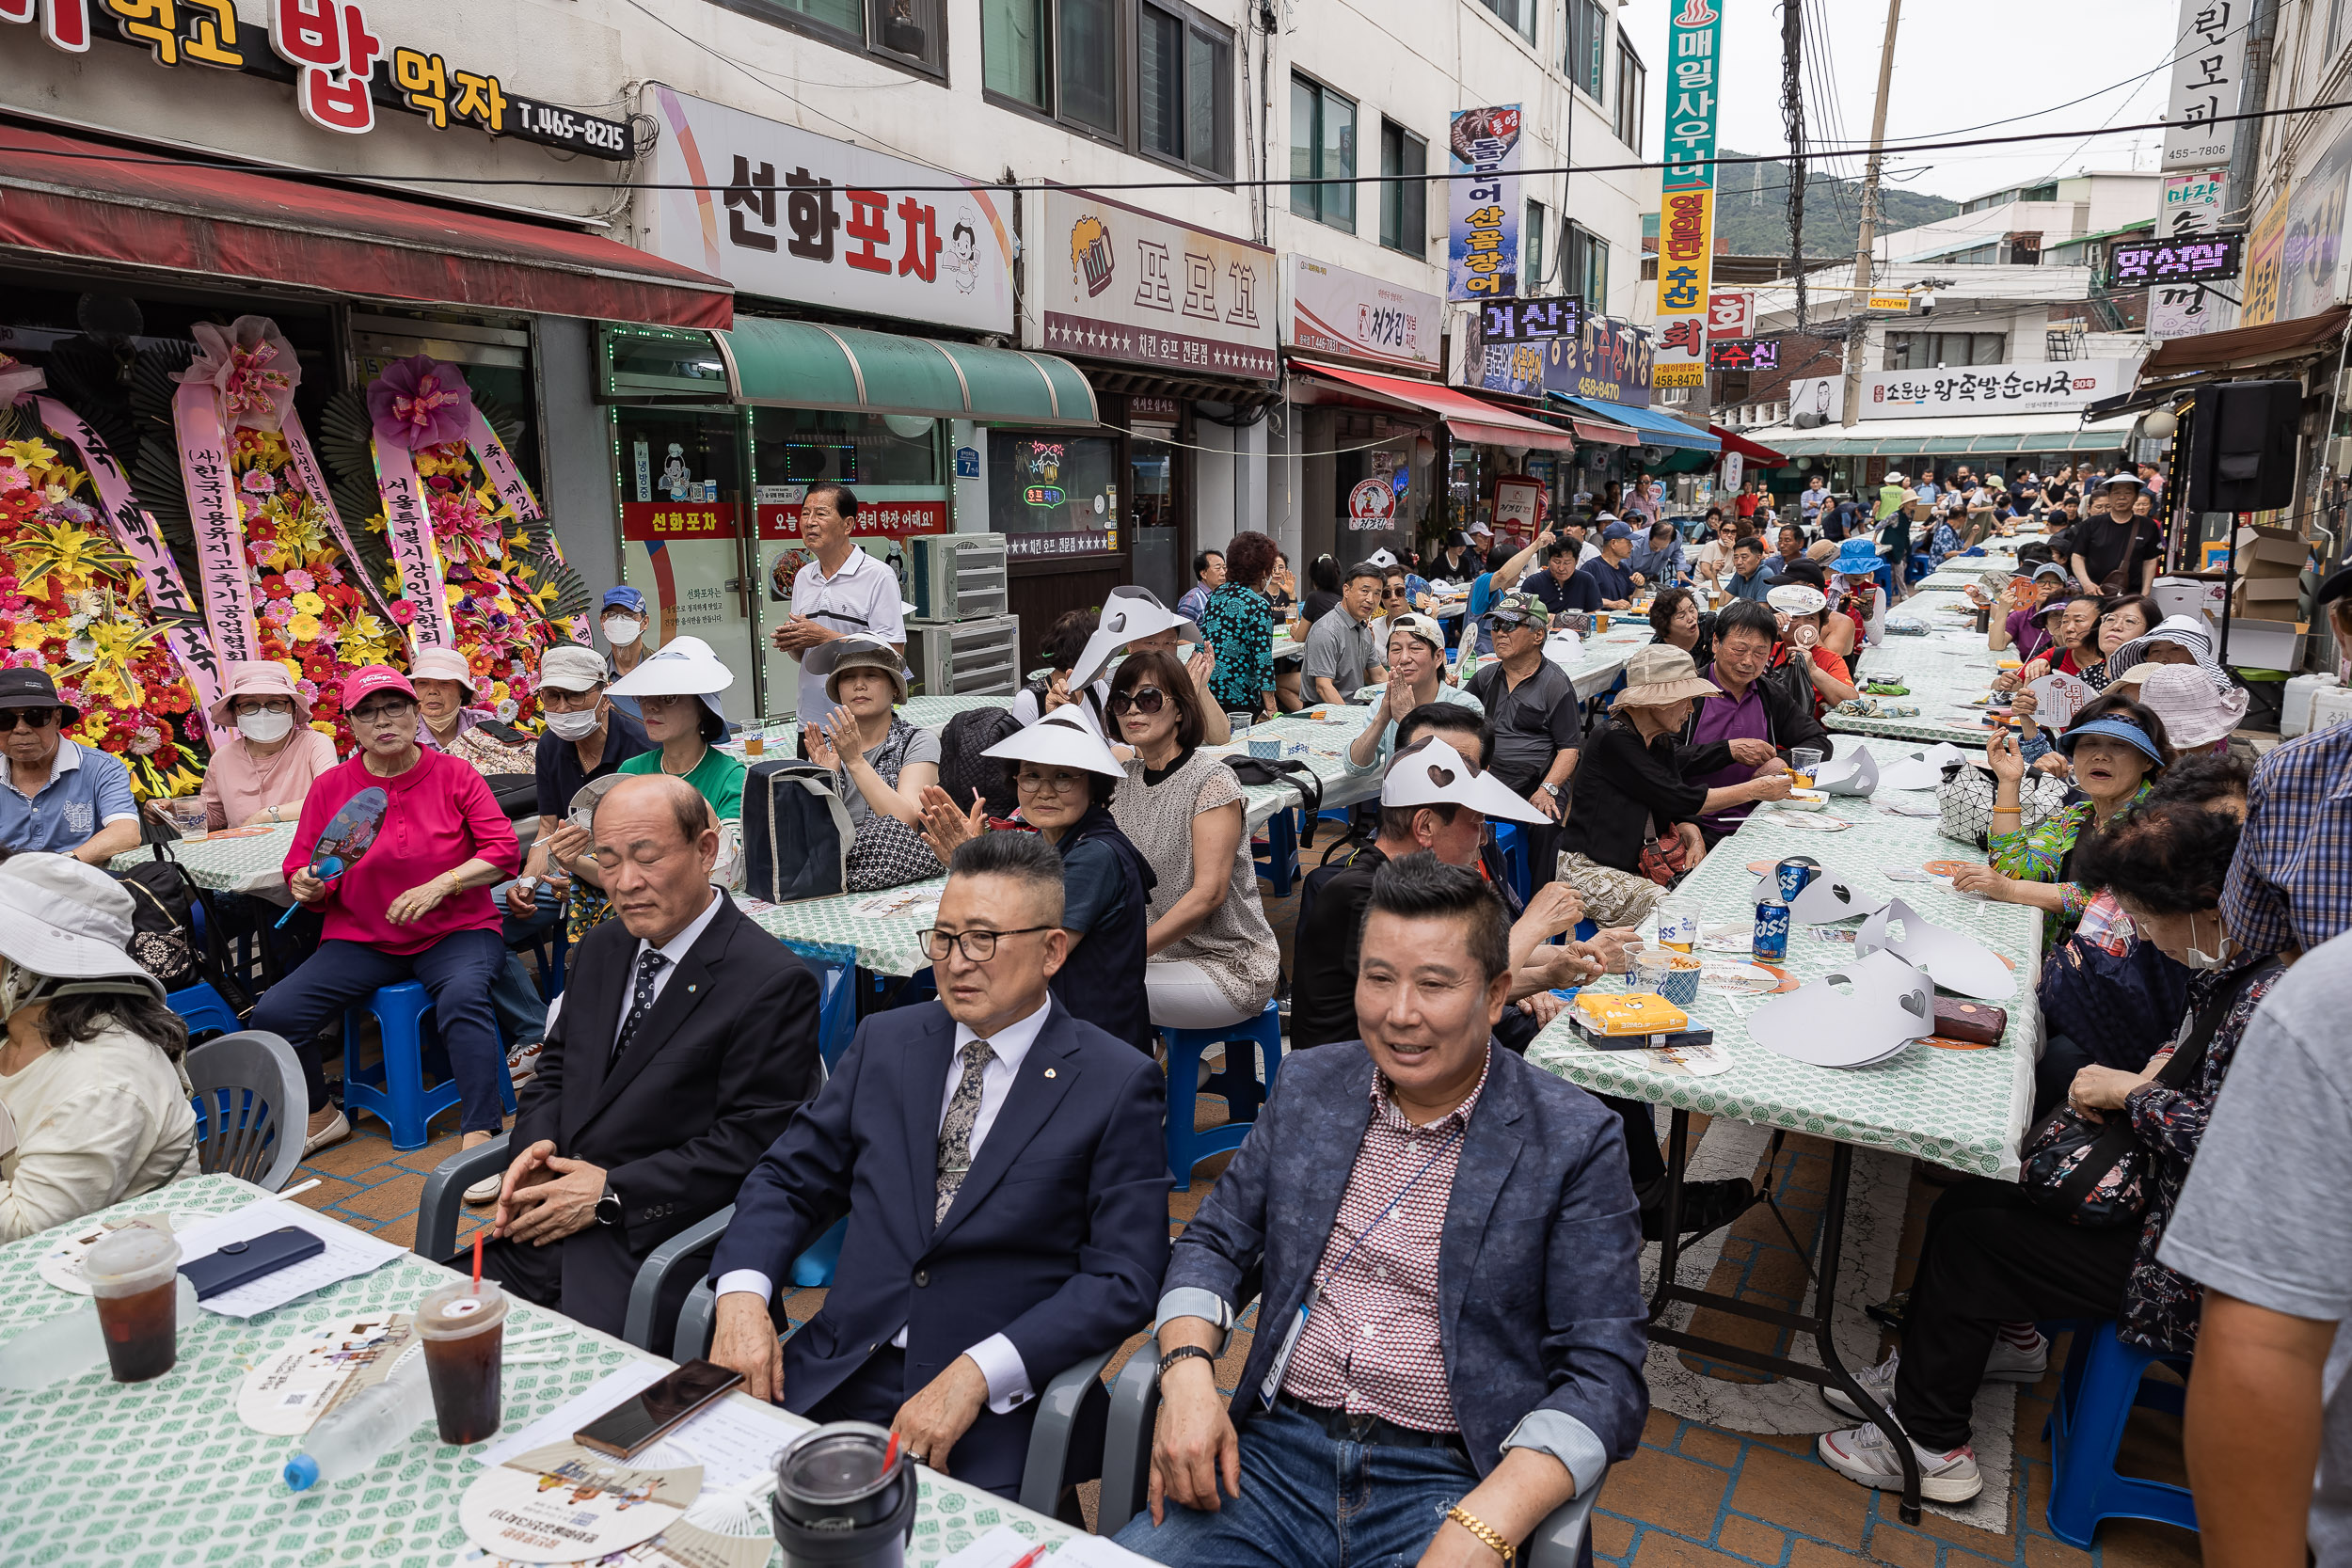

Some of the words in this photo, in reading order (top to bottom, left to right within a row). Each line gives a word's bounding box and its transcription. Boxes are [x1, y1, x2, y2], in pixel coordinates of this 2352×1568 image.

[517, 103, 626, 151] T.465-8215
[2169, 145, 2226, 160] 455-7806
[2167, 182, 2220, 204] 마장
[723, 153, 942, 284] 선화포차
[1870, 299, 1894, 308] CCTV
[1708, 294, 1754, 337] 회
[1371, 307, 1406, 347] 처갓집
[1659, 319, 1702, 357] 회
[1138, 332, 1156, 358] 치킨
[1160, 339, 1179, 360] 호프
[1183, 341, 1209, 366] 전문점
[1662, 364, 1695, 373] 심야영업
[1579, 377, 1620, 401] 458-8470
[1654, 373, 1702, 387] 458-8470
[1887, 382, 1931, 401] 소문난
[1133, 396, 1174, 414] 어서오십시오
[637, 460, 648, 499] 냉방중
[1027, 489, 1043, 502] 호프
[1044, 490, 1060, 503] 치킨
[652, 512, 717, 531] 선화포차
[774, 513, 798, 531] 오늘
[853, 510, 877, 531] 걸리
[880, 510, 899, 530] 한잔
[1030, 539, 1041, 555] 치킨
[1043, 538, 1056, 553] 호프
[1058, 537, 1076, 552] 전문점
[687, 587, 722, 600] 선화포차는
